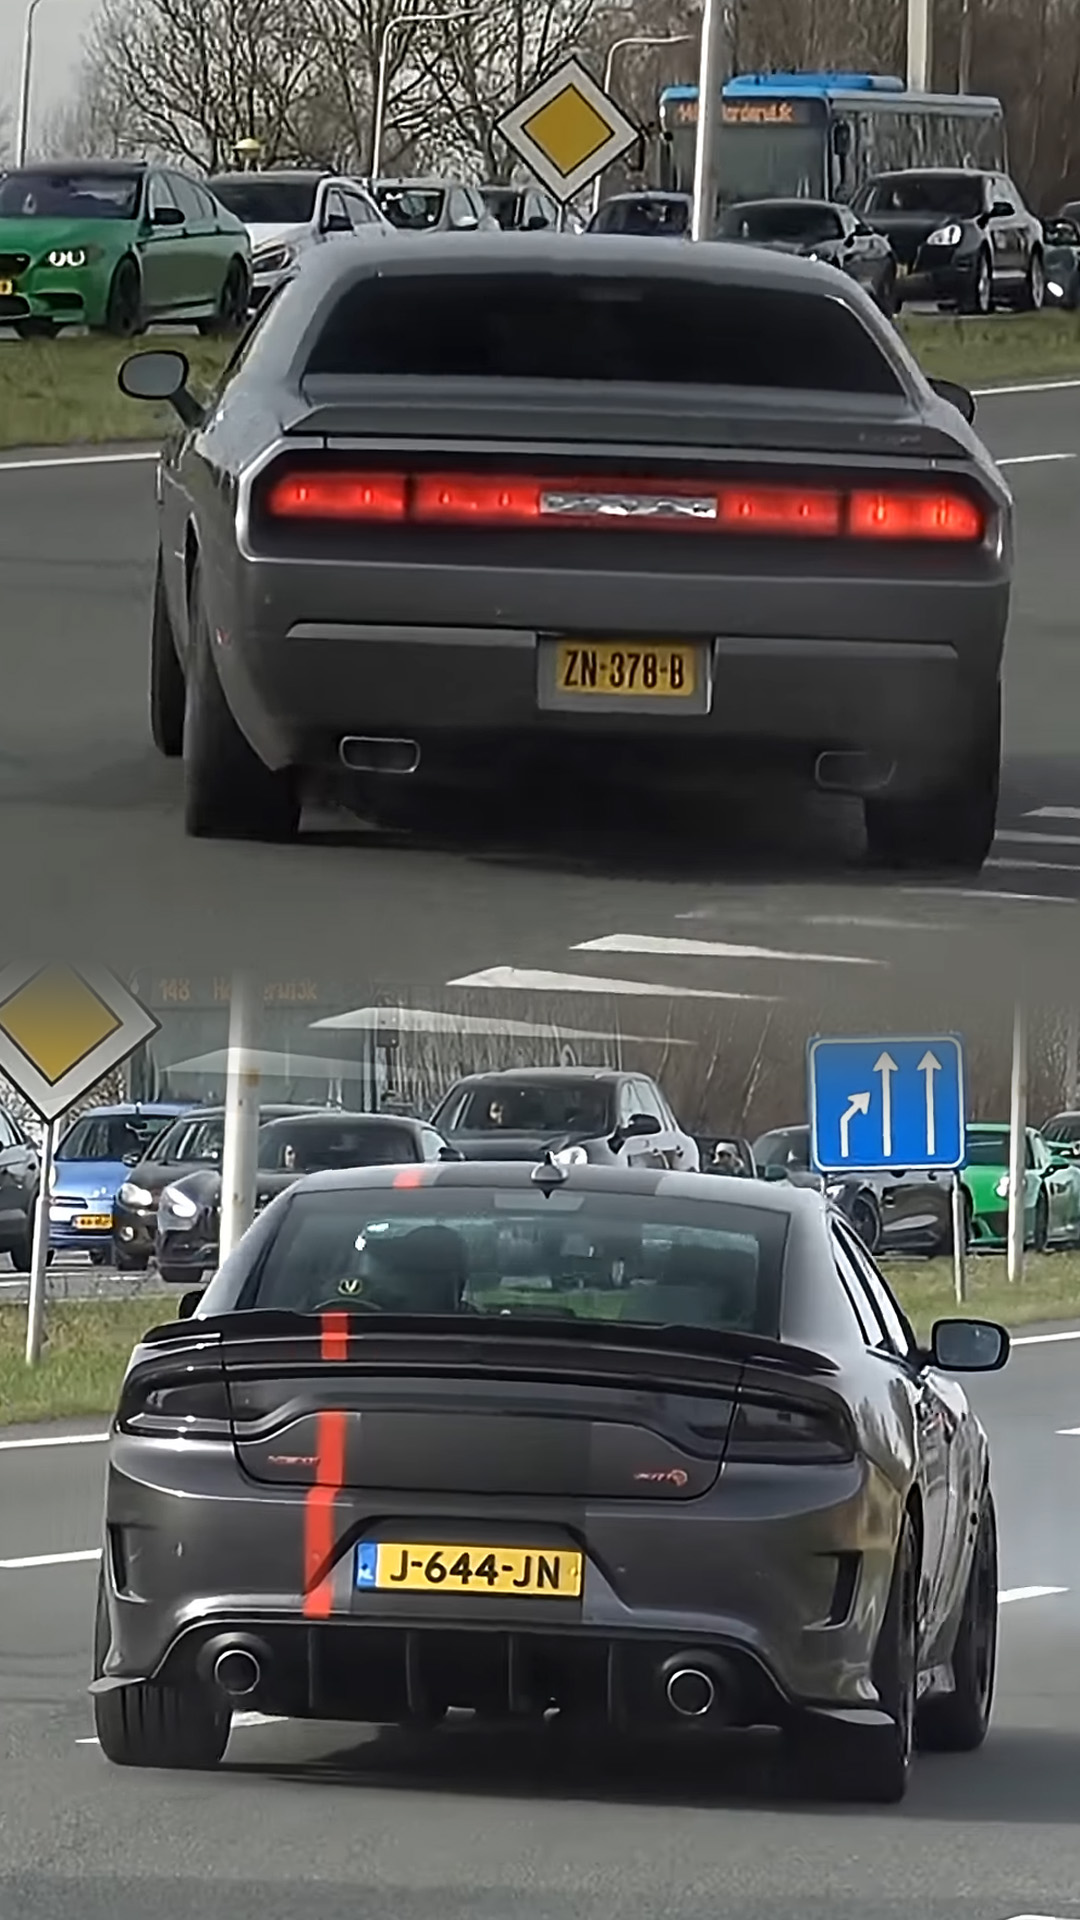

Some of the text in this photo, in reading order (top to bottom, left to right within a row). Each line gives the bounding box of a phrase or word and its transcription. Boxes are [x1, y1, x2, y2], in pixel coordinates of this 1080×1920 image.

[563, 650, 684, 689] ZN-378-B
[159, 978, 191, 1001] 148
[389, 1549, 560, 1589] J-644-JN
